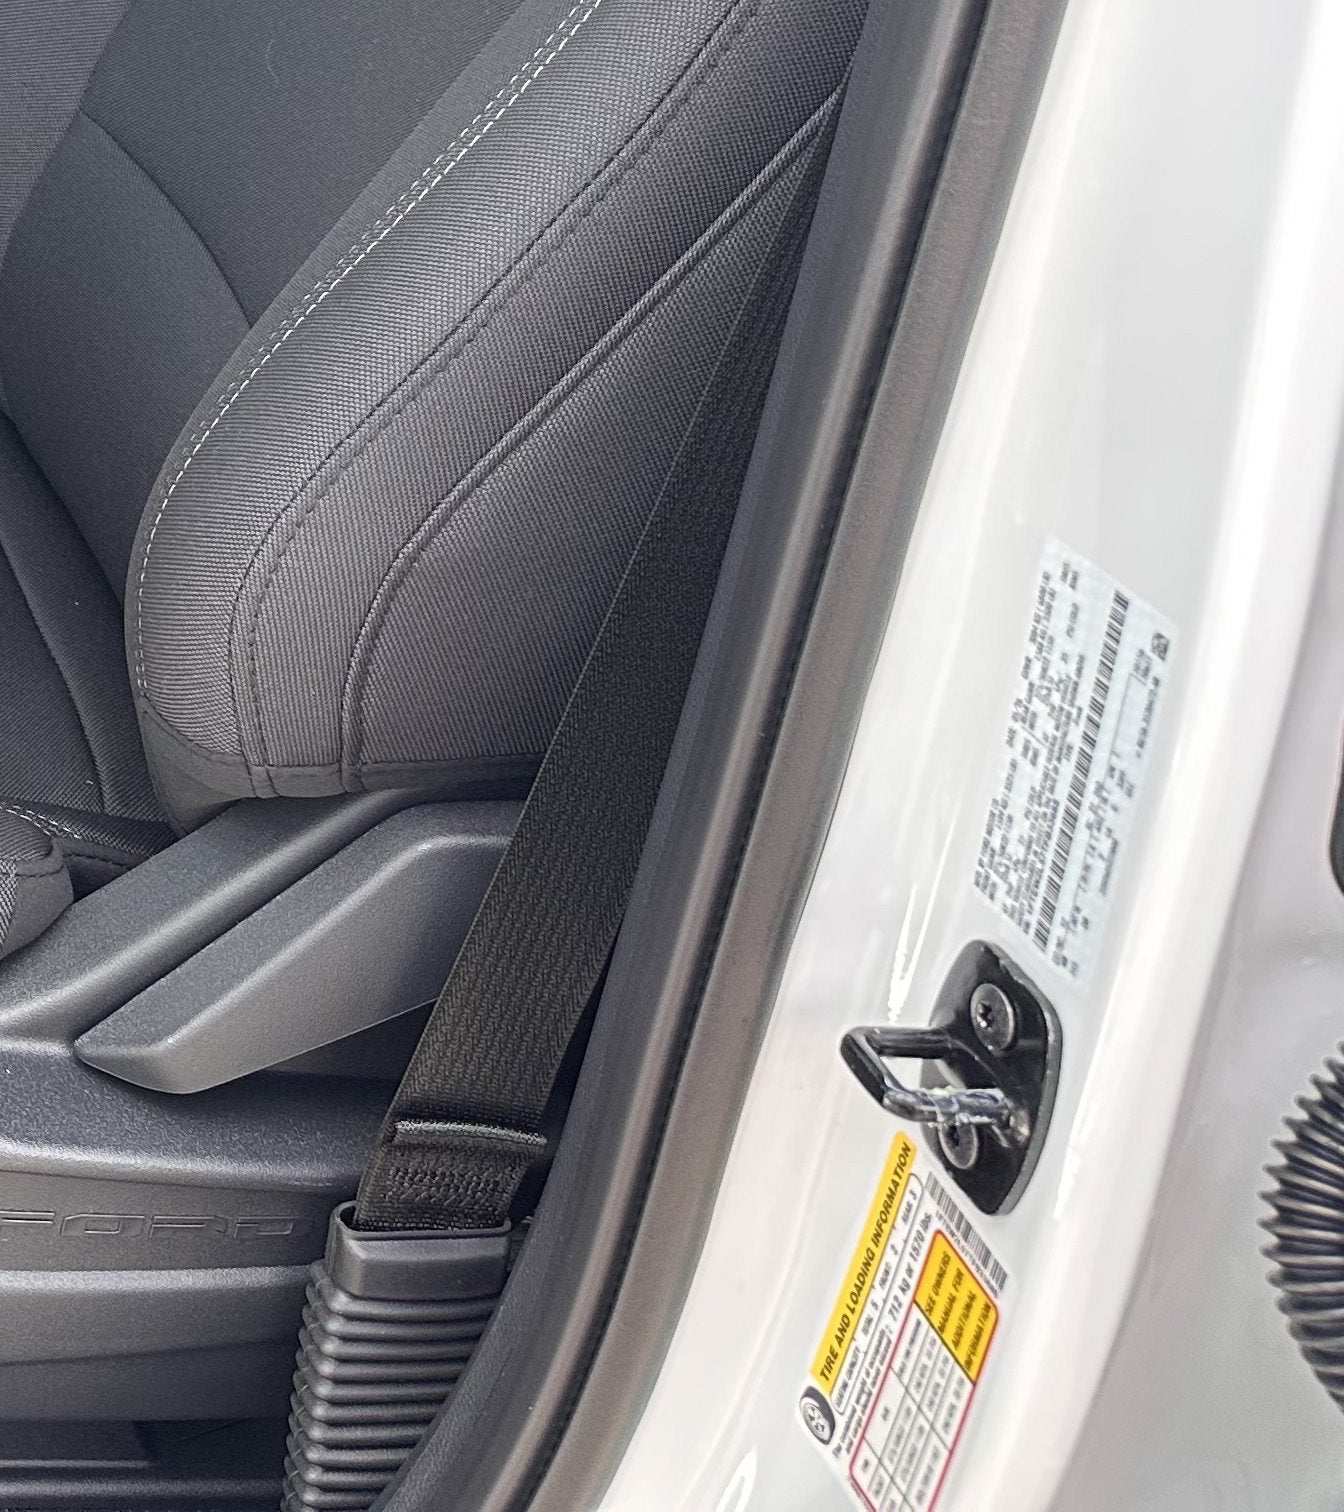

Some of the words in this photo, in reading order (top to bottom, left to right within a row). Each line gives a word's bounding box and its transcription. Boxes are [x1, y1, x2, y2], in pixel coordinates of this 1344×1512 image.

[890, 1244, 899, 1256] 2
[909, 1189, 917, 1201] 3
[909, 1229, 925, 1262] 1570
[820, 1345, 839, 1381] TIRE
[834, 1313, 851, 1348] AND
[846, 1247, 875, 1315] LOADING
[871, 1142, 911, 1247] INFORMATION
[905, 1263, 914, 1279] or
[887, 1294, 903, 1322] 712
[898, 1277, 911, 1296] kg
[925, 1295, 936, 1316] SEE
[937, 1293, 957, 1335] MANUAL
[952, 1268, 964, 1292] FOR
[952, 1291, 977, 1350] ADDITIONAL
[964, 1302, 992, 1371] INFORMATION
